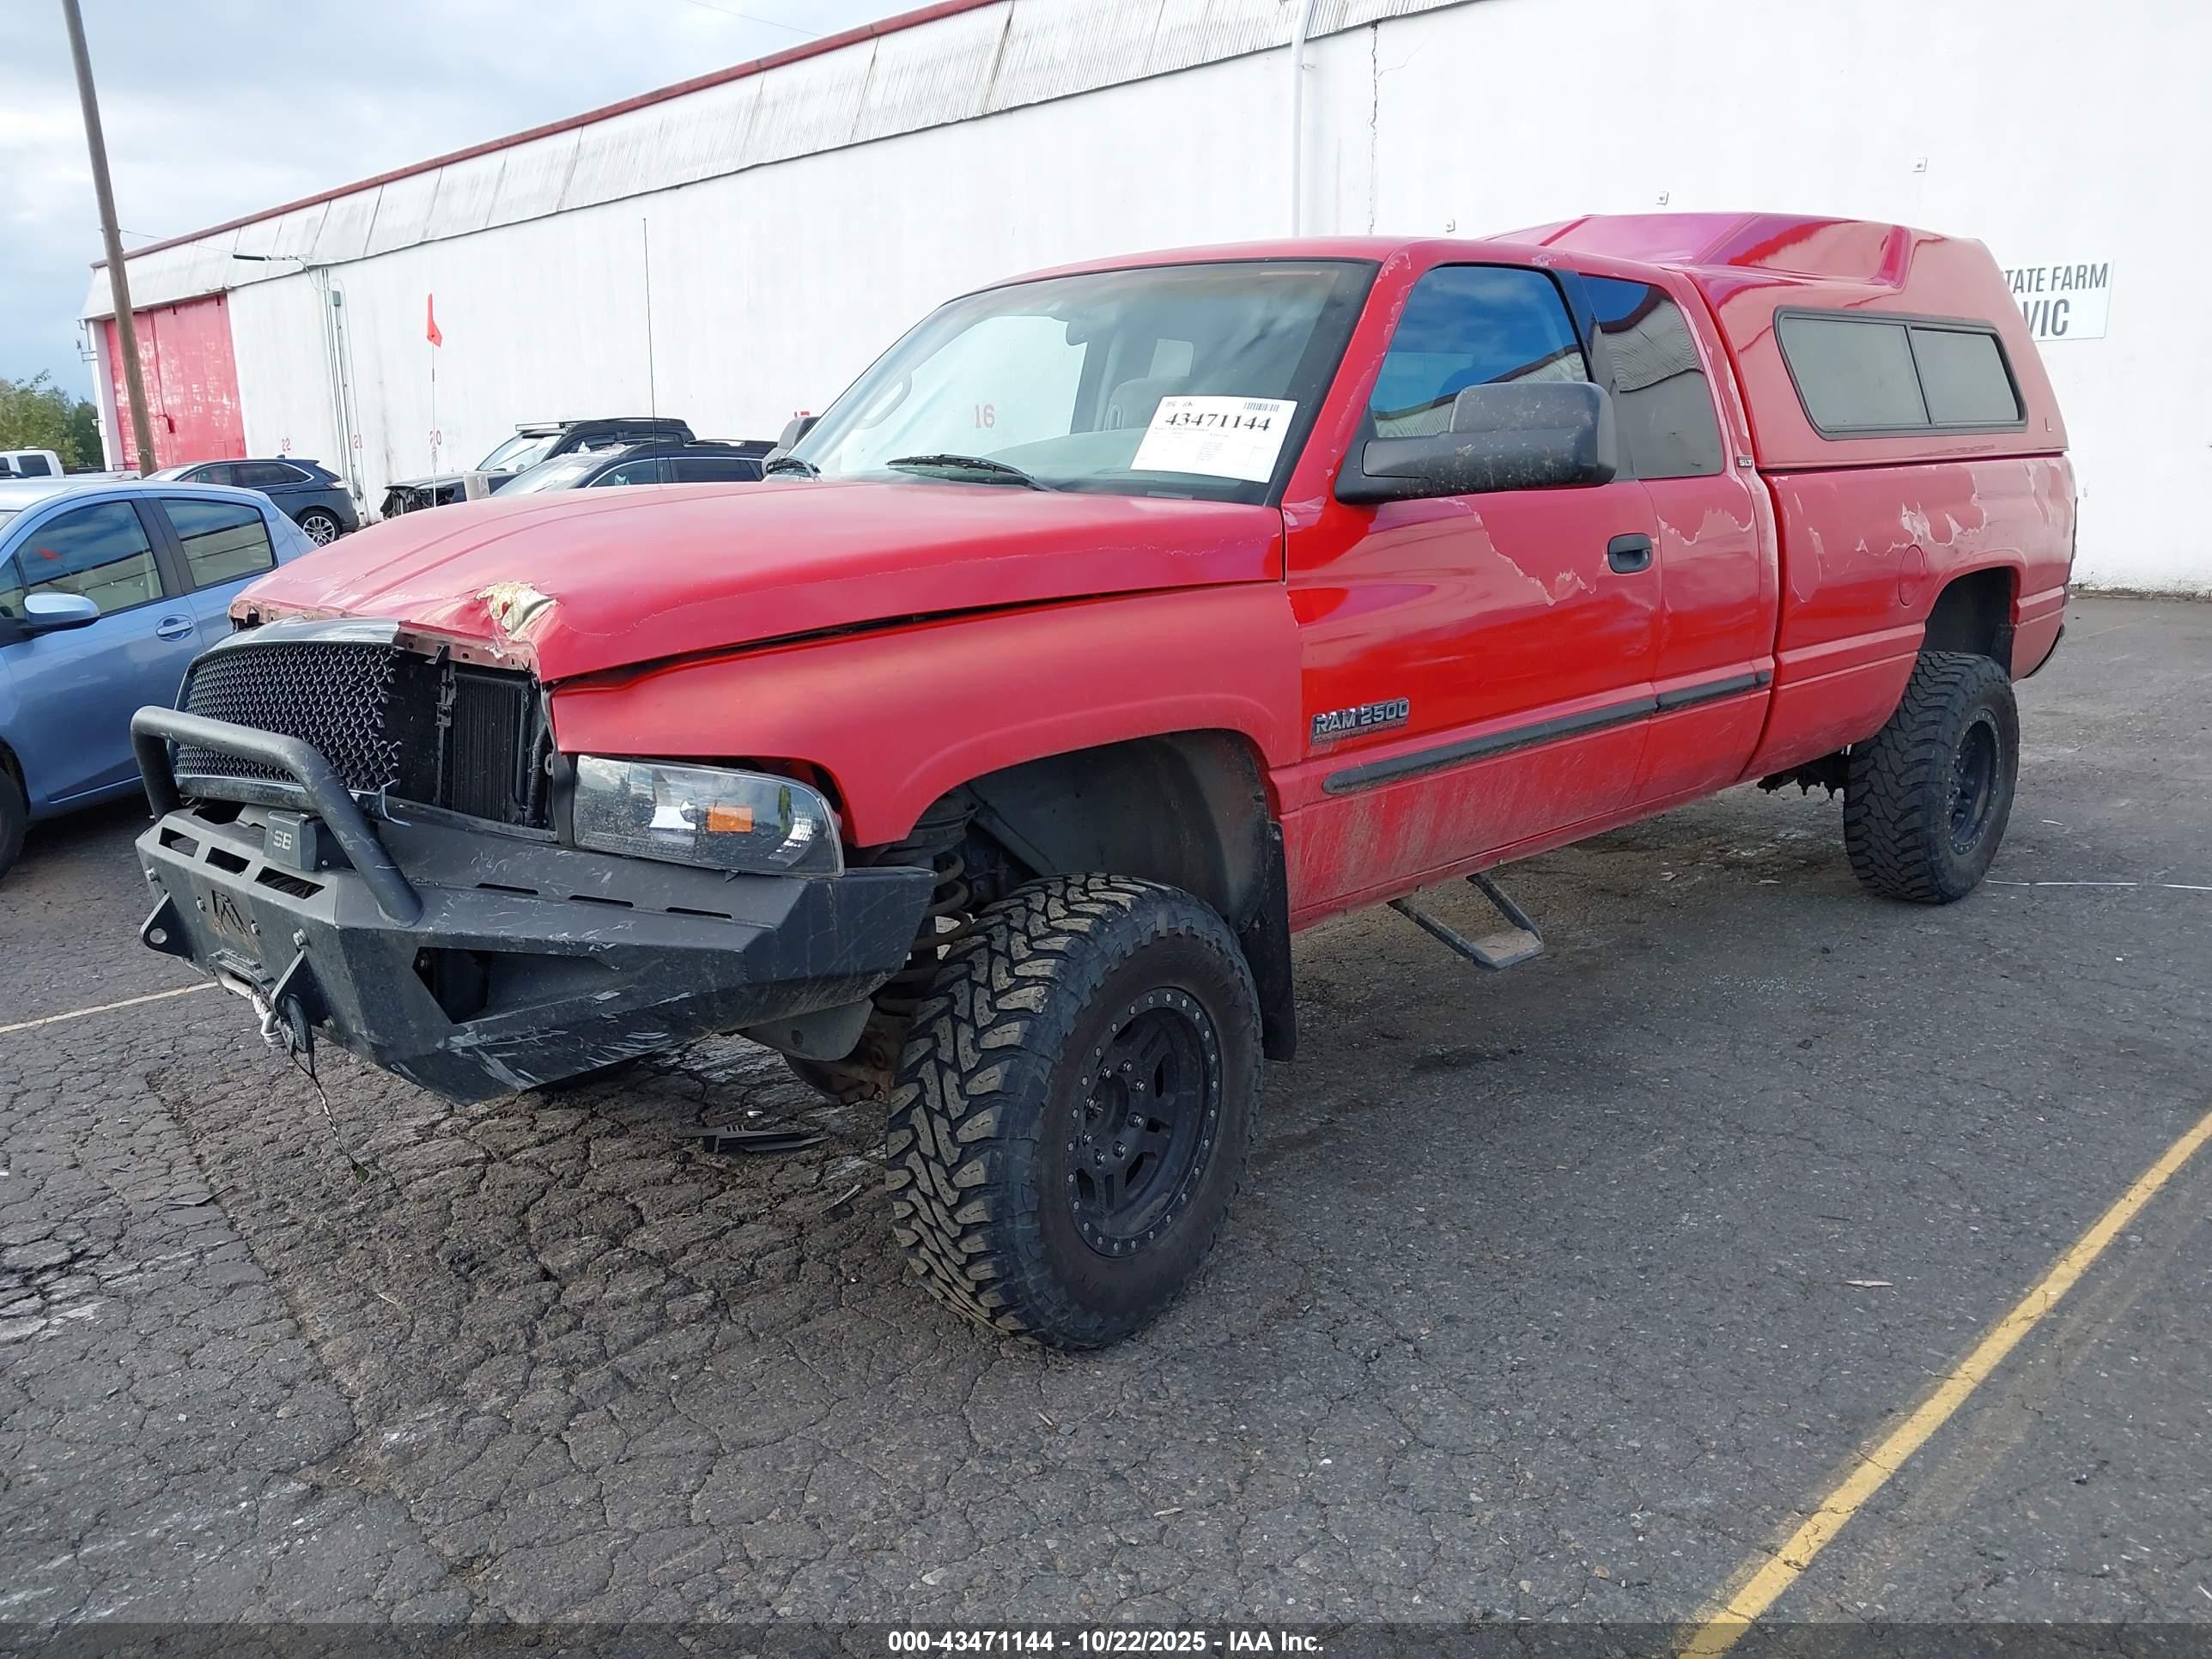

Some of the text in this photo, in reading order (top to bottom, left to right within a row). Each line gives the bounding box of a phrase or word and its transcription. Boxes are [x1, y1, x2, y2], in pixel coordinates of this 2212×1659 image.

[2003, 263, 2108, 294] TATE FARM
[2022, 298, 2070, 337] VIC
[975, 404, 995, 429] 16
[1165, 412, 1271, 431] 43471144
[281, 437, 291, 452] 22
[1739, 459, 1753, 467] SLT
[1315, 708, 1356, 734] RAM
[1360, 698, 1410, 726] 2500
